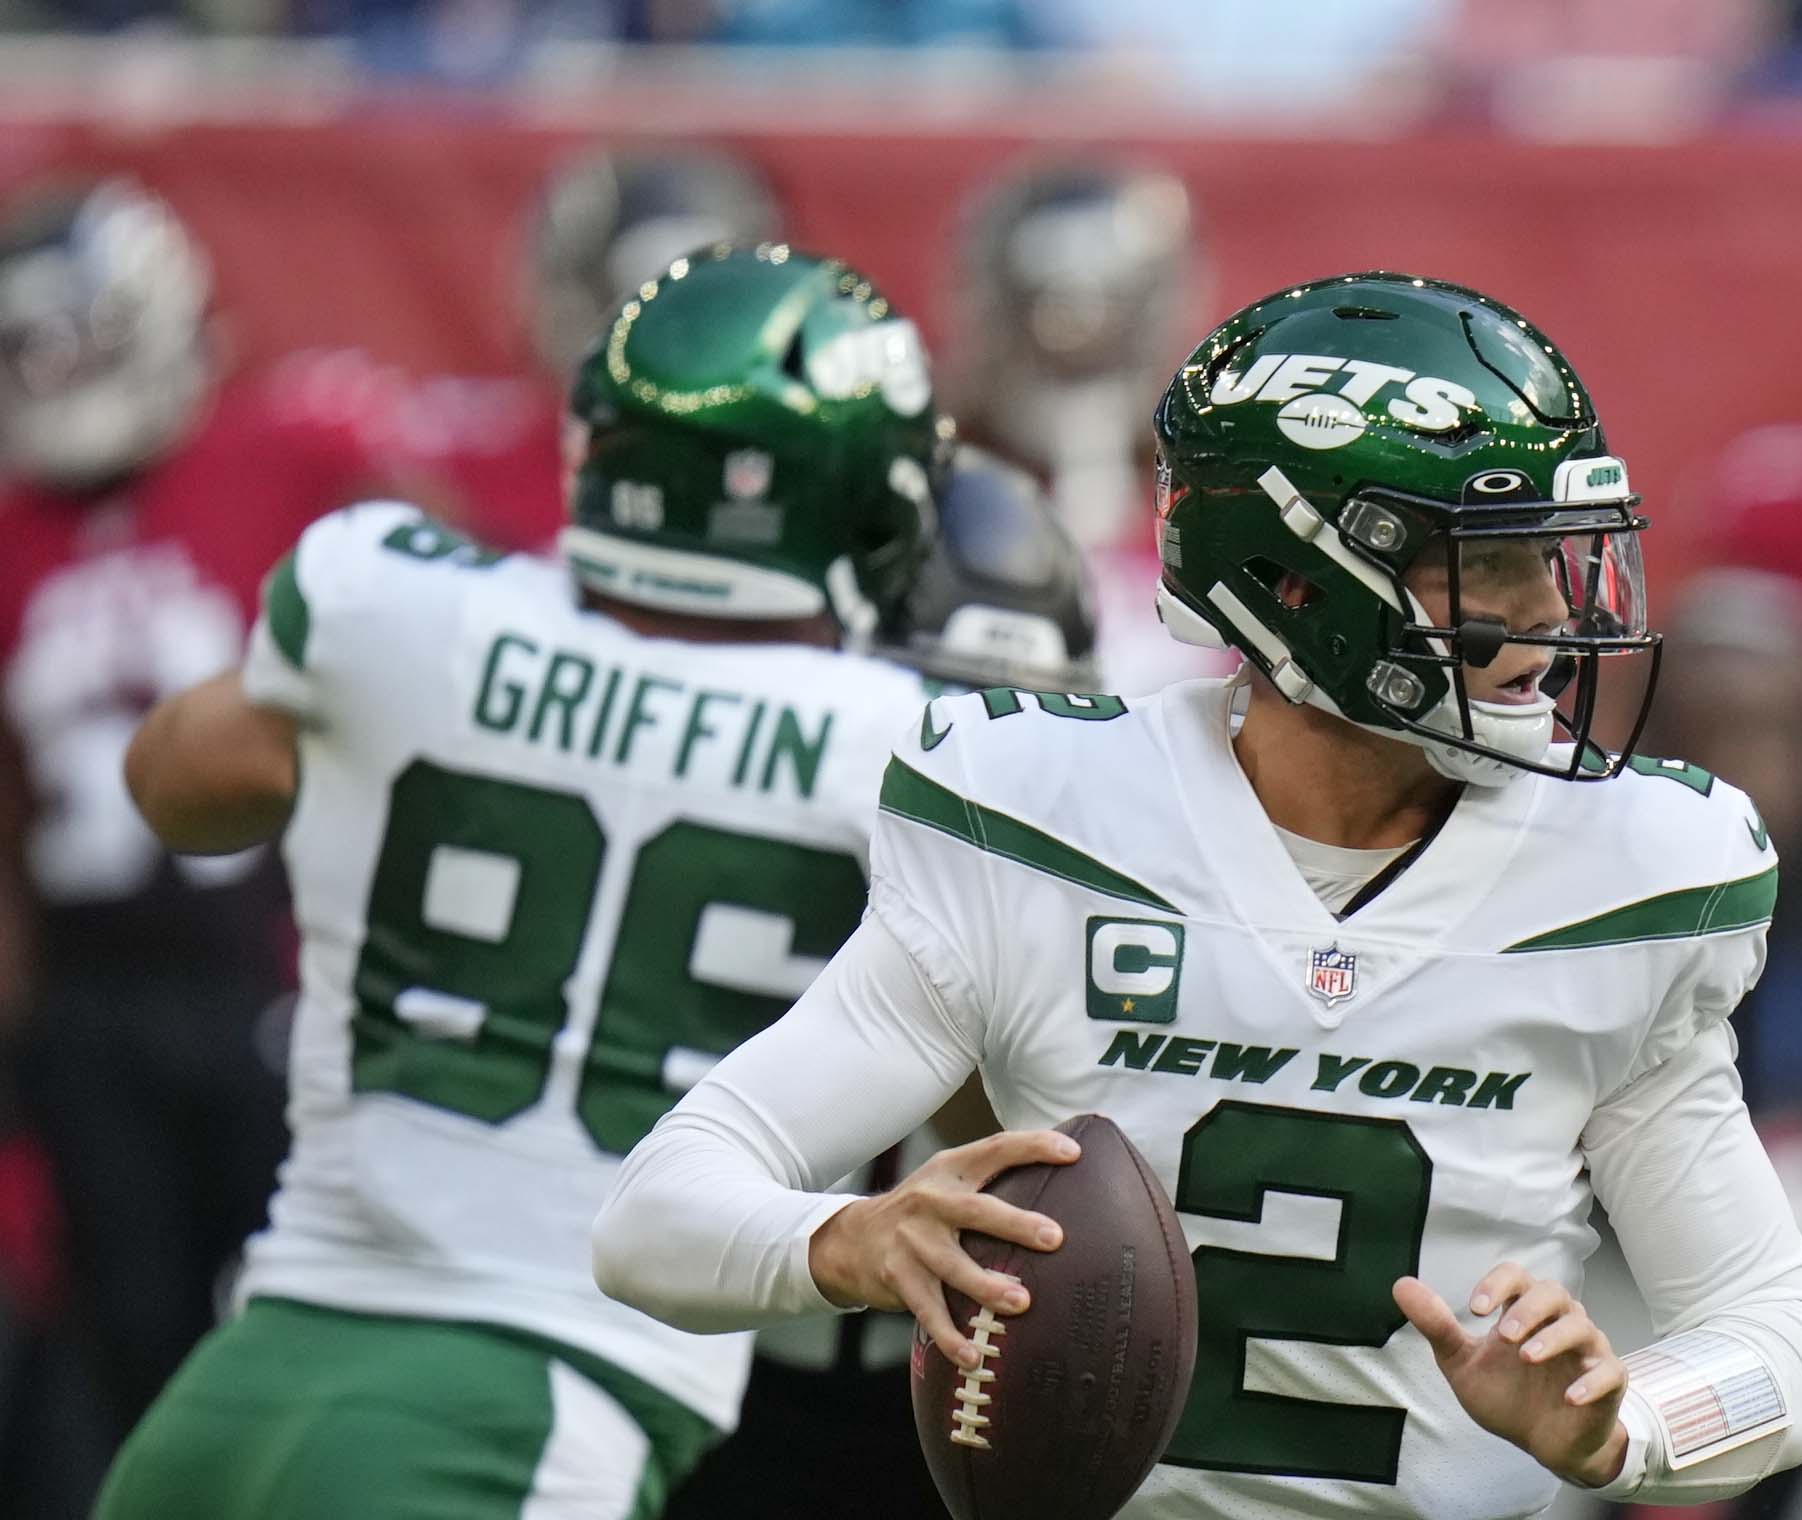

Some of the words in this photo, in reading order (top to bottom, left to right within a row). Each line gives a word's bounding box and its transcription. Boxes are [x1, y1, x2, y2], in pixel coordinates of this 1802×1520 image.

[1210, 353, 1477, 433] JETS
[472, 633, 834, 800] GRIFFIN
[351, 752, 871, 1160] 86
[1092, 922, 1177, 996] C
[1097, 1029, 1301, 1084] NEW
[1309, 1053, 1533, 1111] YORK
[1160, 1098, 1435, 1487] 2
